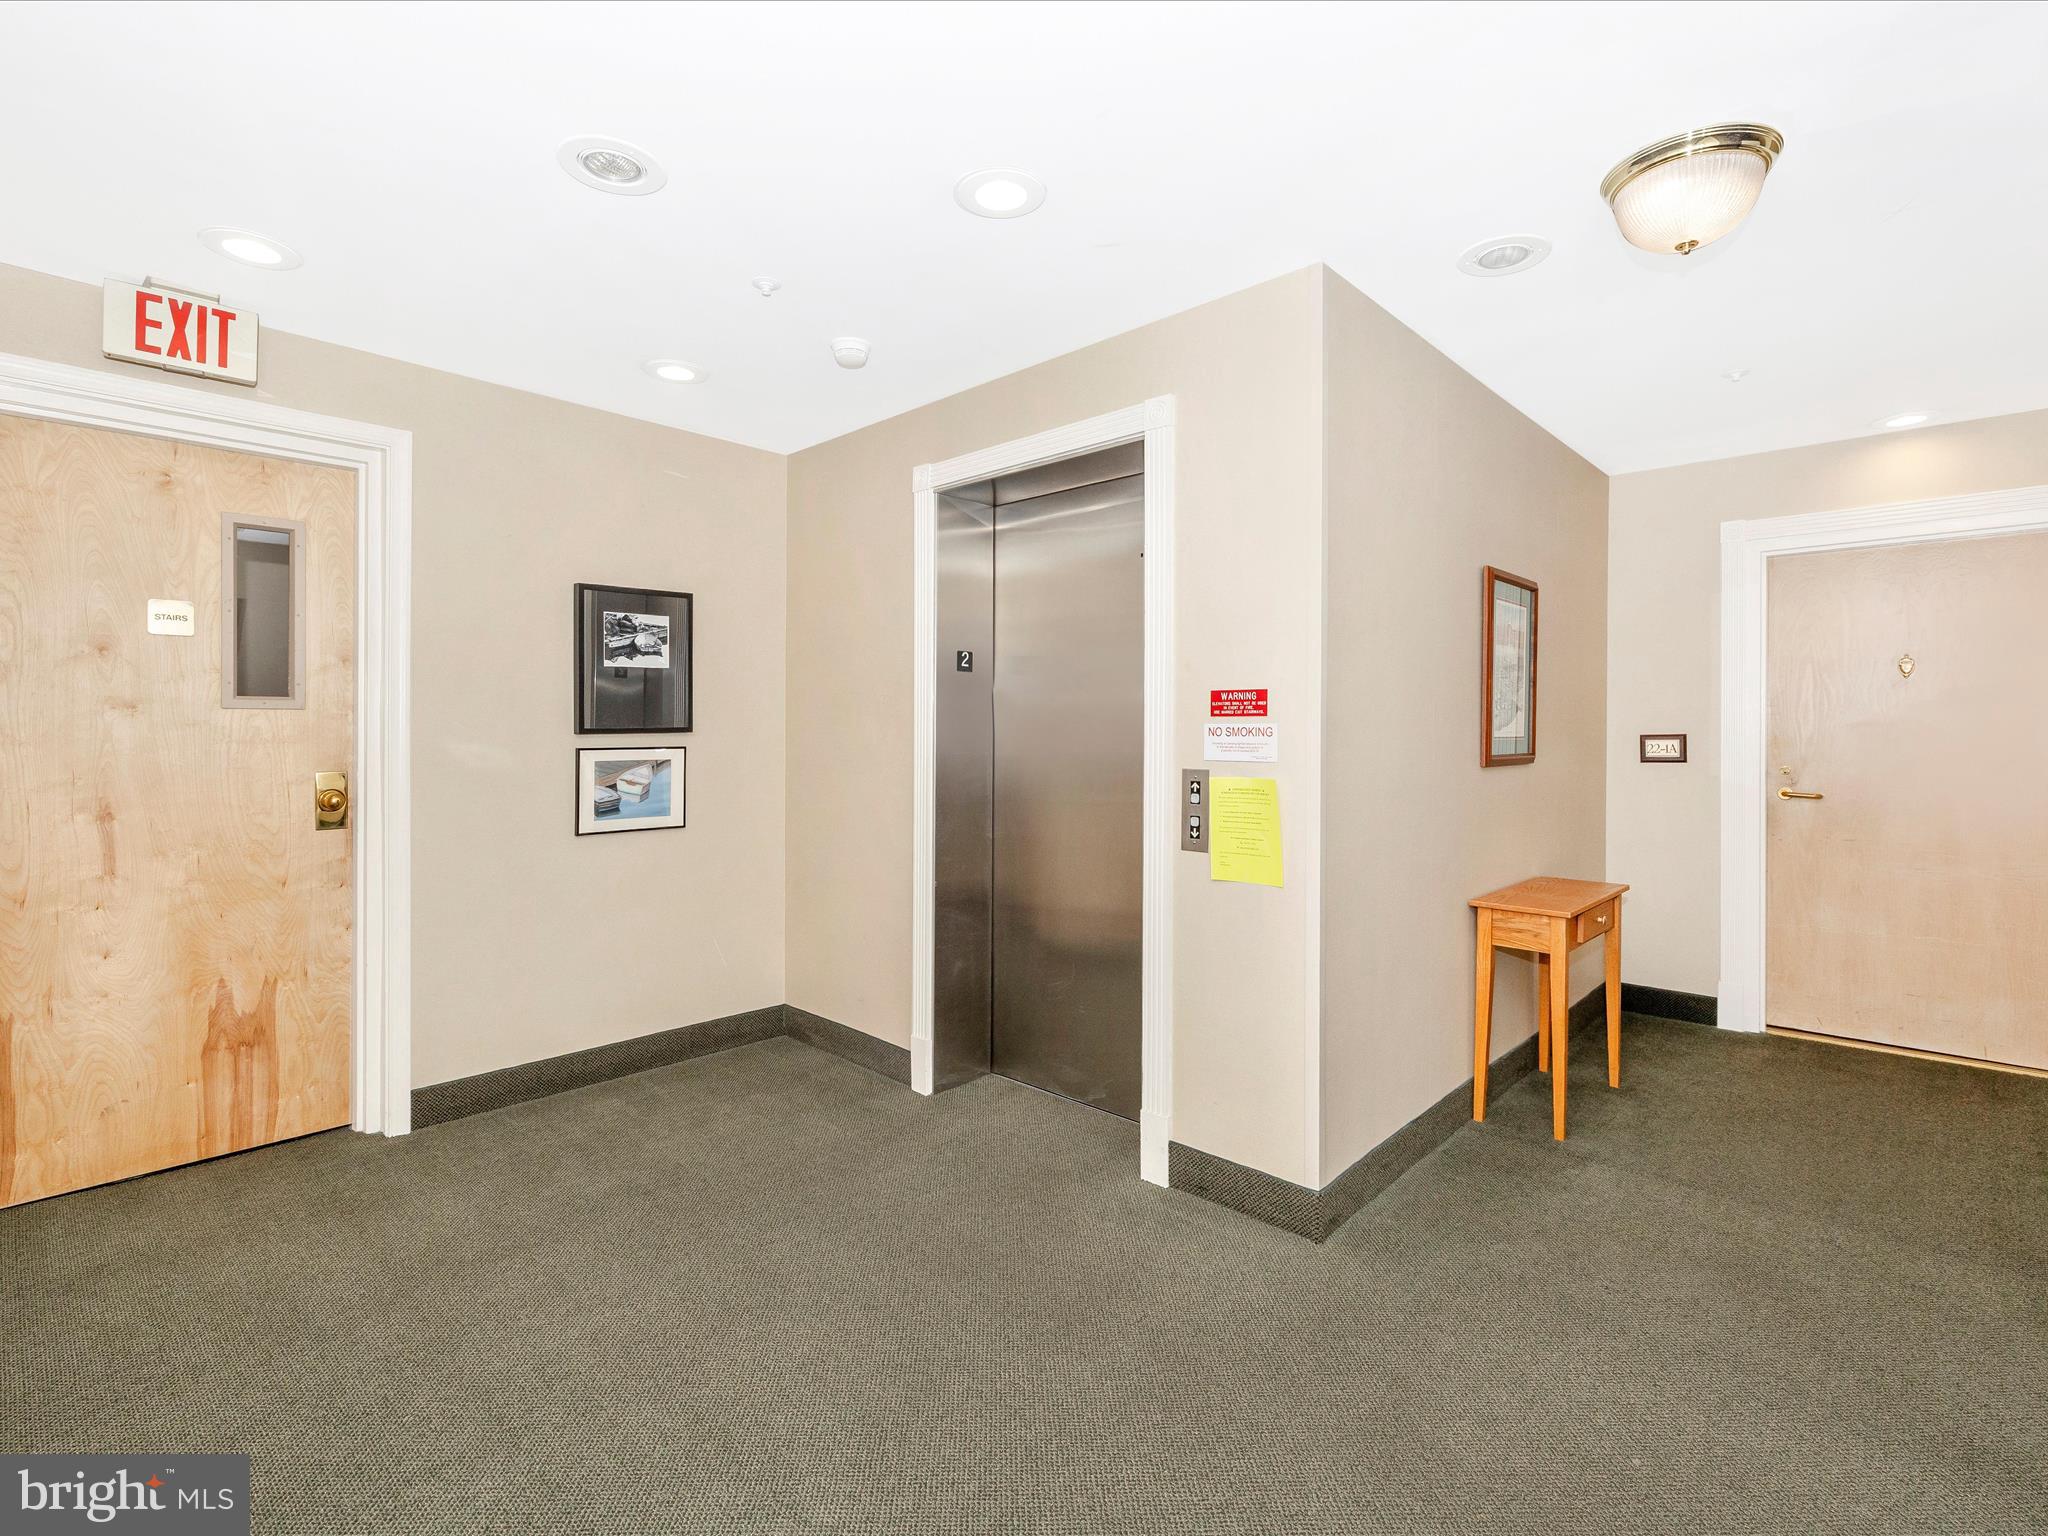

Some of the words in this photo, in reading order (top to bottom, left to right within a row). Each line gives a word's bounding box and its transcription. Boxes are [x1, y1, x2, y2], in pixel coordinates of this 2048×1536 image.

[135, 290, 237, 369] EXIT
[154, 613, 189, 622] STAIRS
[961, 651, 969, 667] 2
[1220, 691, 1257, 701] WARNING
[1208, 726, 1223, 737] NO
[1225, 726, 1274, 738] SMOKING
